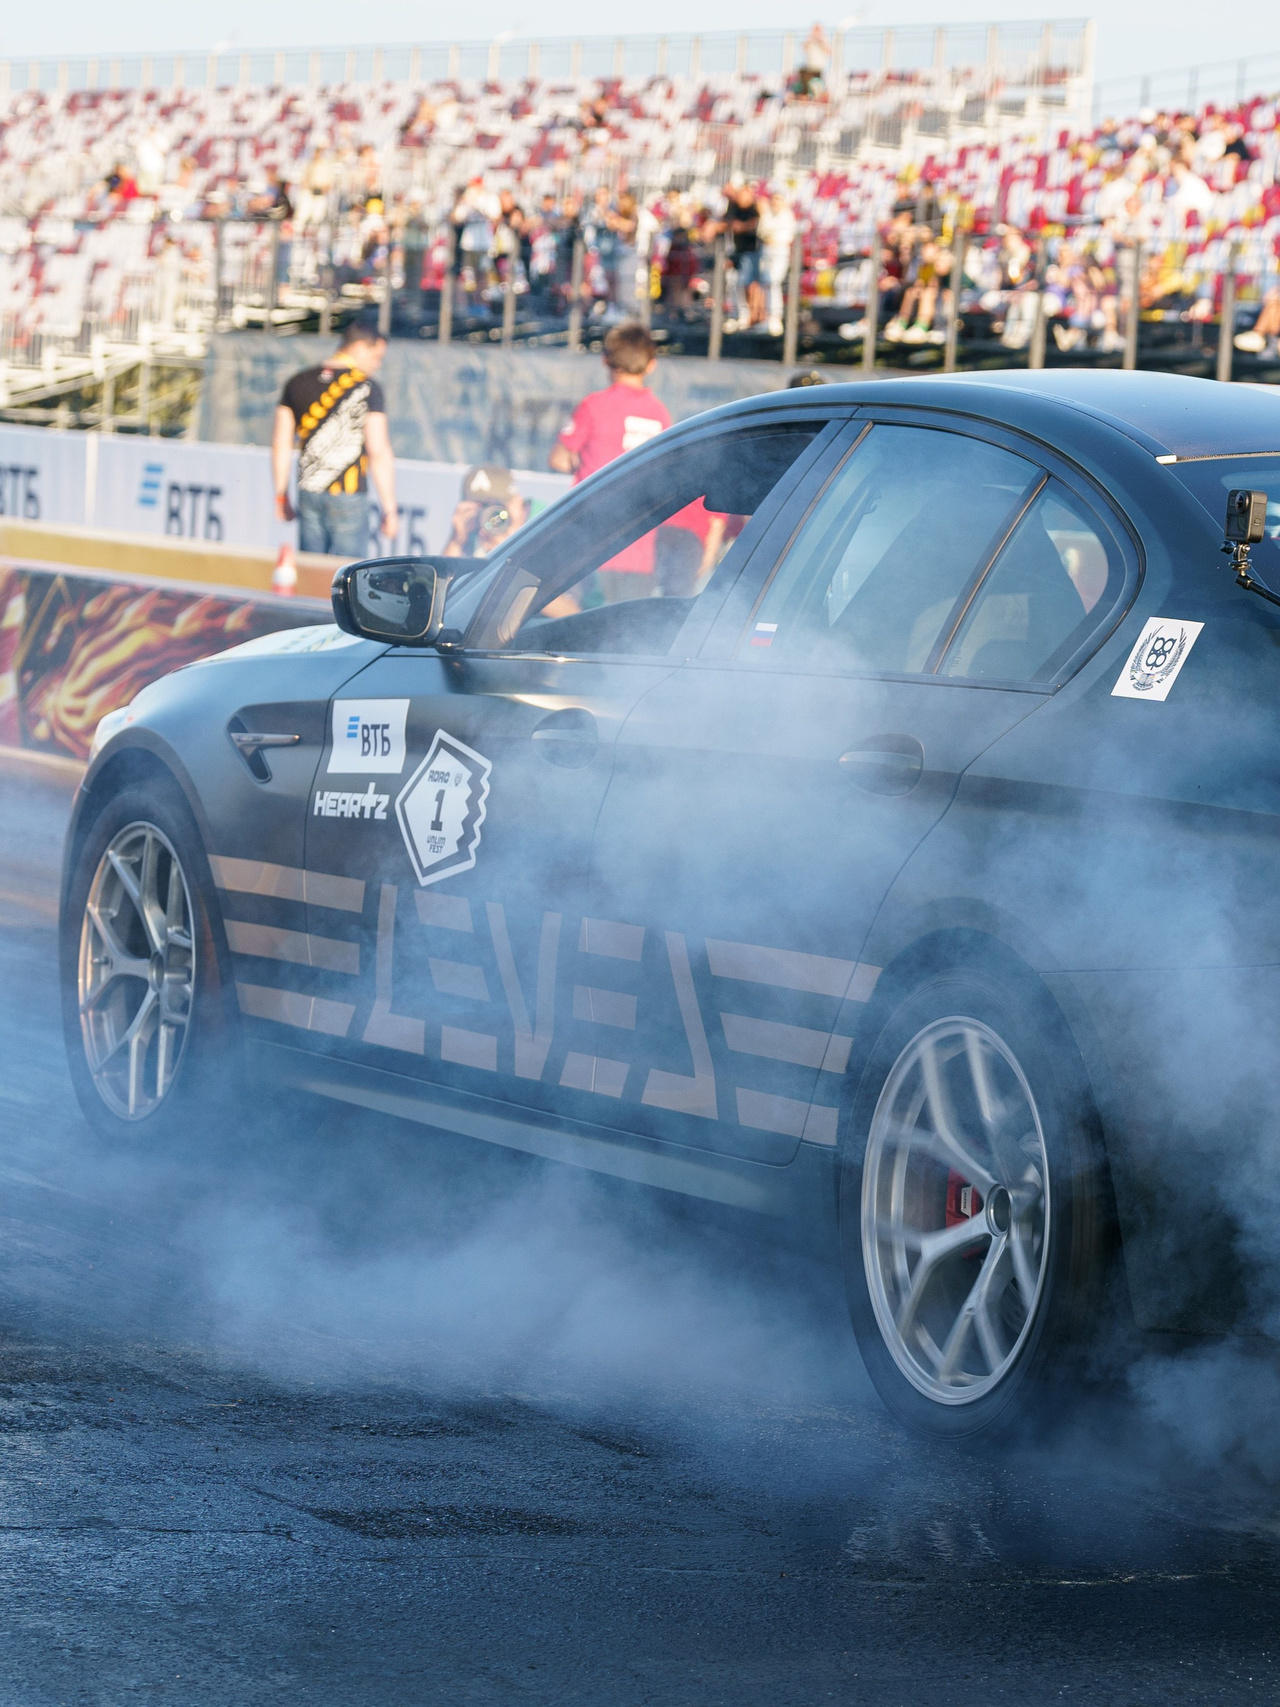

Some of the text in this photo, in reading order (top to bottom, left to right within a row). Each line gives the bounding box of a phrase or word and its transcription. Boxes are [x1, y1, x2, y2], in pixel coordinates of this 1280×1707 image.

[166, 481, 224, 541] ВТБ
[361, 723, 391, 757] ВТБ
[430, 789, 446, 832] 1
[428, 845, 444, 854] FEST
